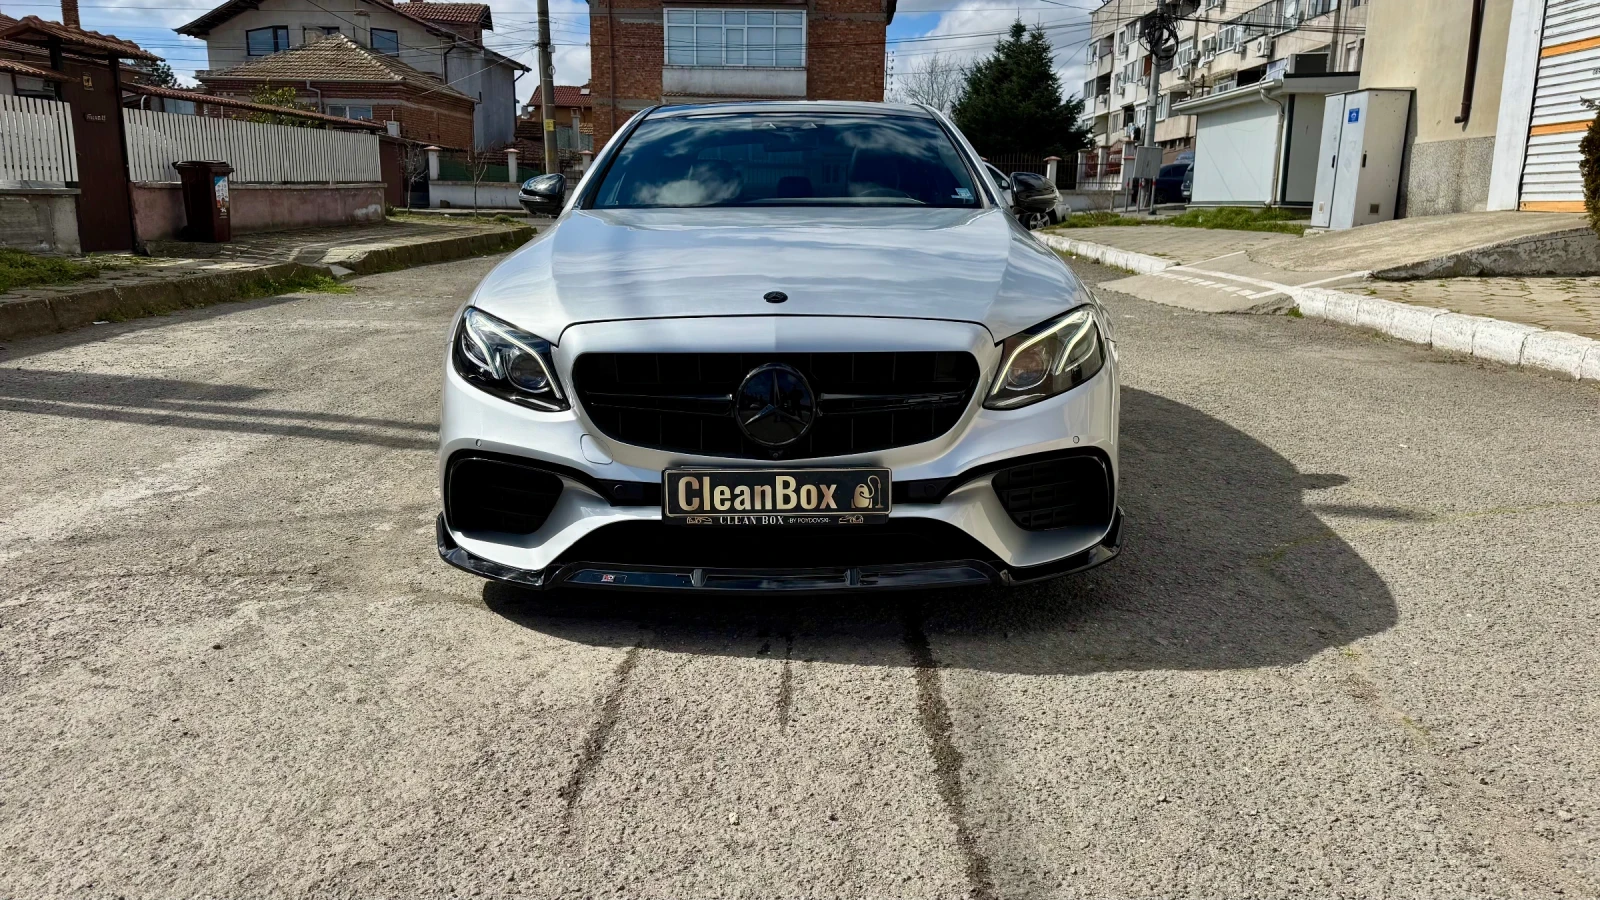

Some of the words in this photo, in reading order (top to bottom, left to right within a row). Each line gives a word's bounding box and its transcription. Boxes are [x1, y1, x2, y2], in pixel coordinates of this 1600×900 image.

[678, 475, 838, 511] CleanBox
[719, 515, 757, 525] CLEAN
[762, 515, 784, 525] BOX
